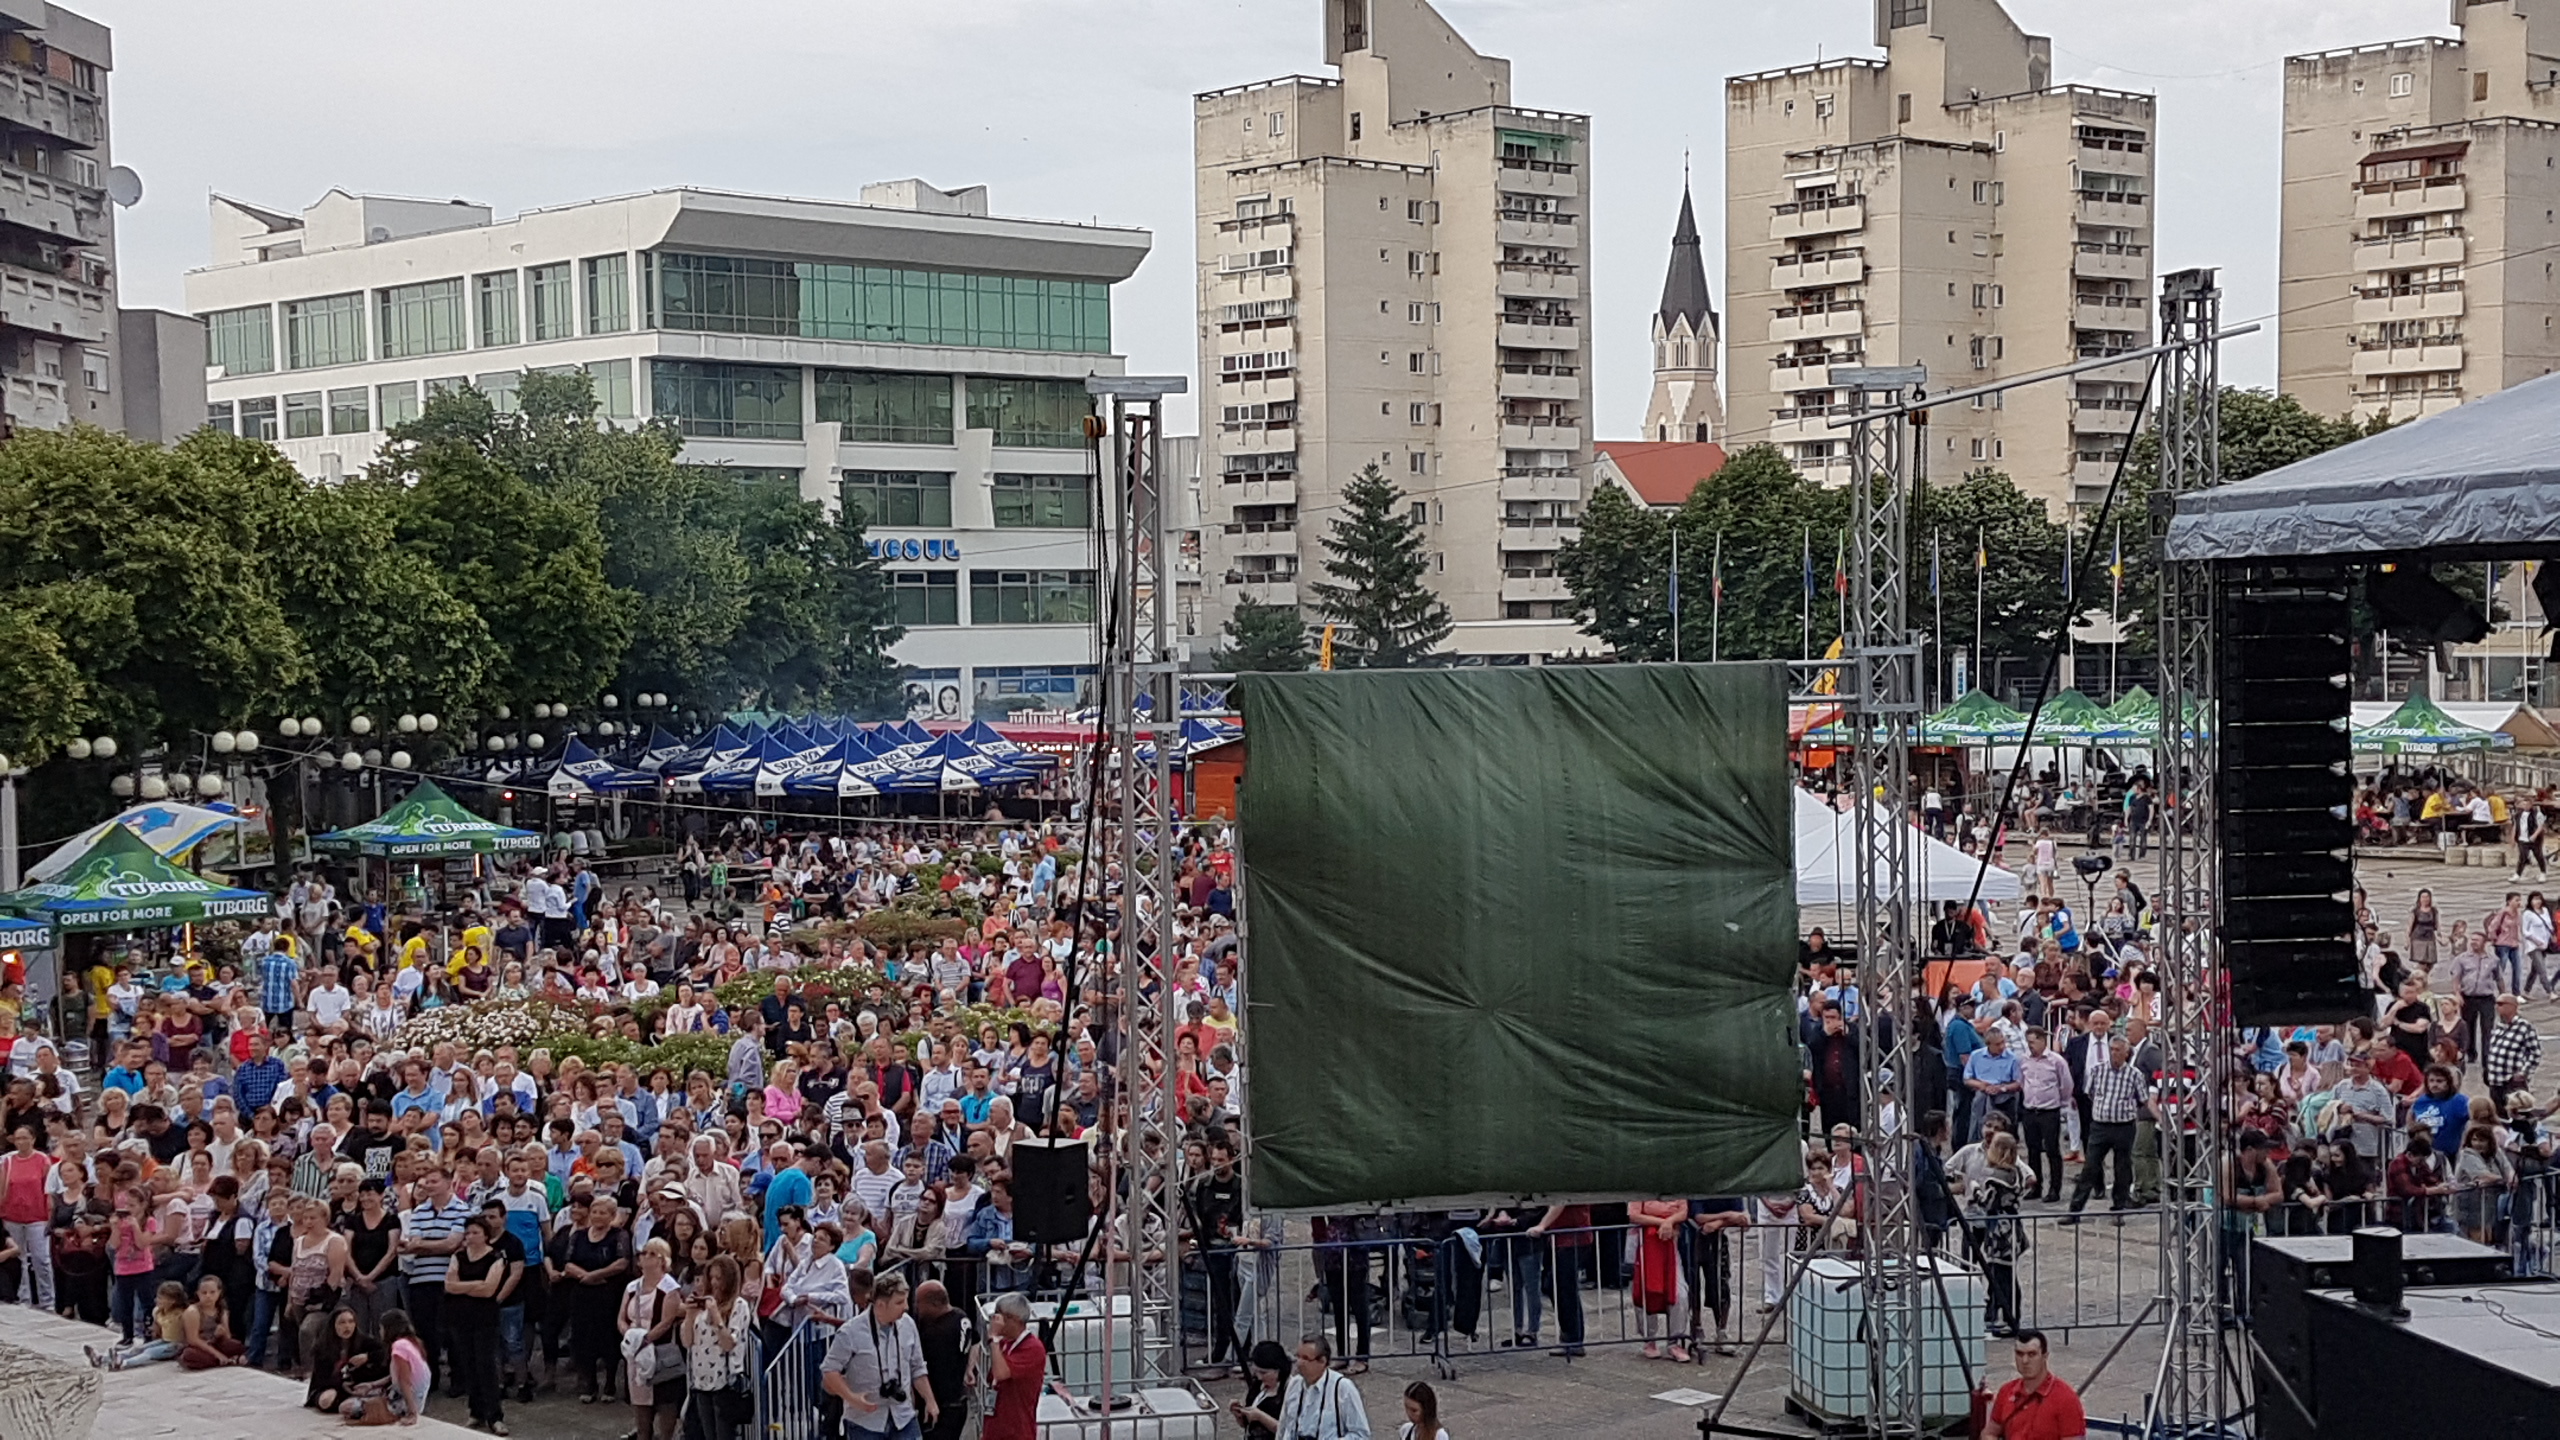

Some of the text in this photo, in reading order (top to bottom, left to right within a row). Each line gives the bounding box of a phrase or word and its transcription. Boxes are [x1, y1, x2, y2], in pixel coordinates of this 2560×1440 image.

[2399, 742, 2438, 754] TUBORG
[425, 821, 497, 833] TUBORG
[392, 844, 419, 855] OPEN
[421, 842, 441, 853] FOR
[443, 840, 472, 851] MORE
[492, 836, 541, 849] TUBORG
[110, 880, 210, 898] TUBORG
[201, 898, 268, 917] TUBORG
[60, 911, 100, 926] OPEN
[102, 909, 130, 922] FOR
[132, 906, 172, 920] MORE
